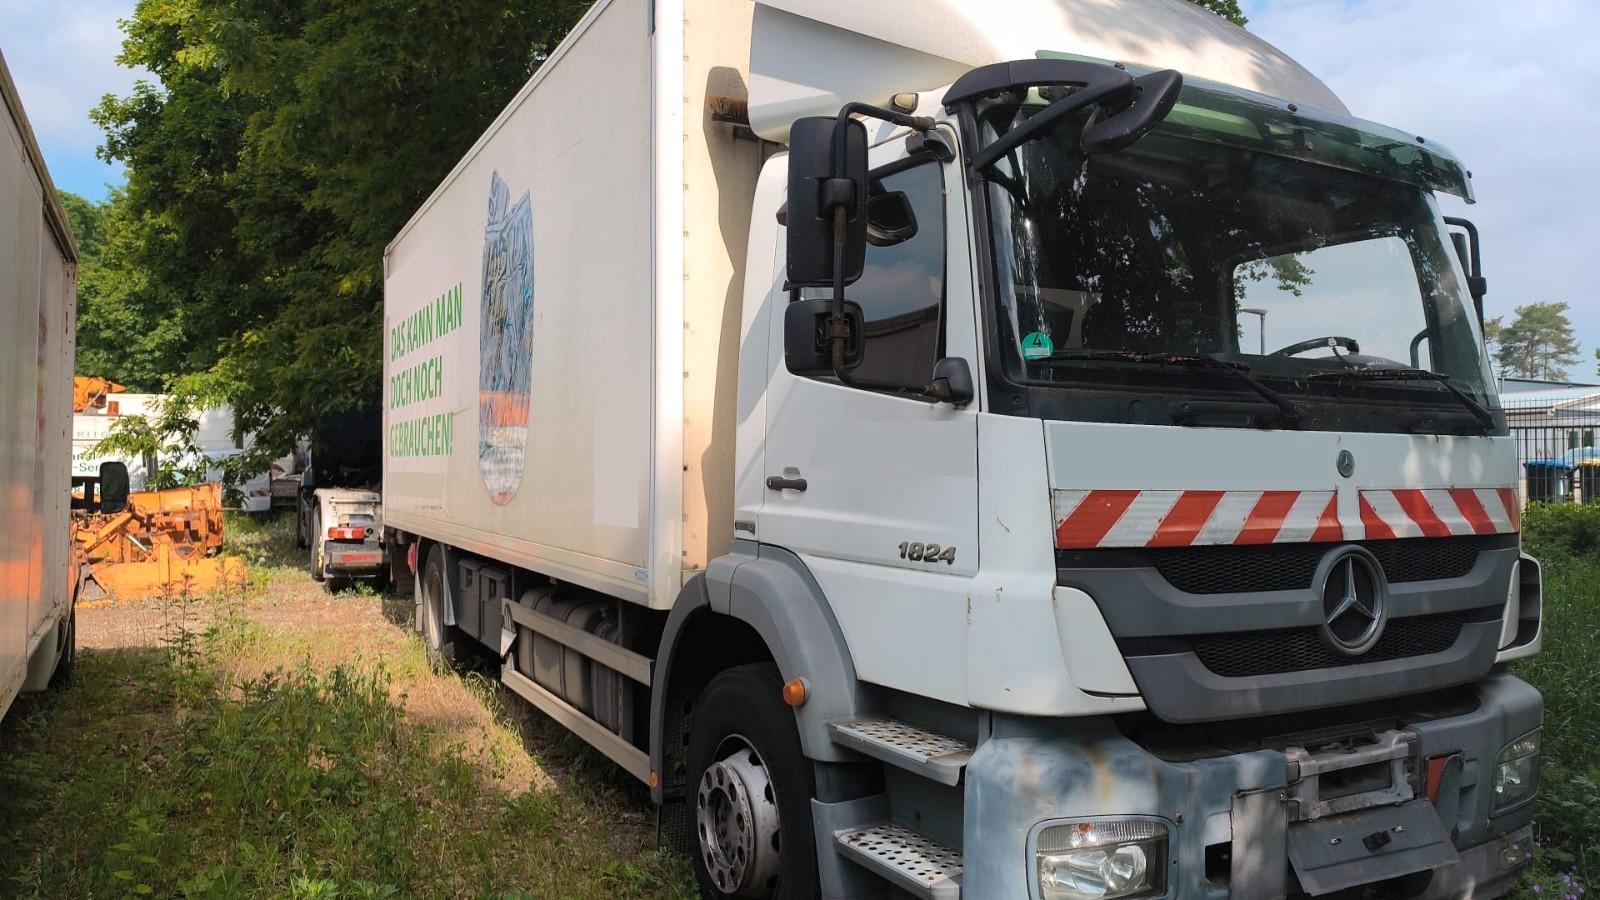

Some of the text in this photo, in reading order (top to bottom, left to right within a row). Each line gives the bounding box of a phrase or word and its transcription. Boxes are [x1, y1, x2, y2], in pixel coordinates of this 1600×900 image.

[391, 282, 462, 362] DAS KANN MAN
[1033, 333, 1041, 347] 4
[390, 355, 442, 410] DOCH NOCH
[390, 412, 453, 458] GEBRAUCHEN!
[898, 541, 957, 565] 1824
